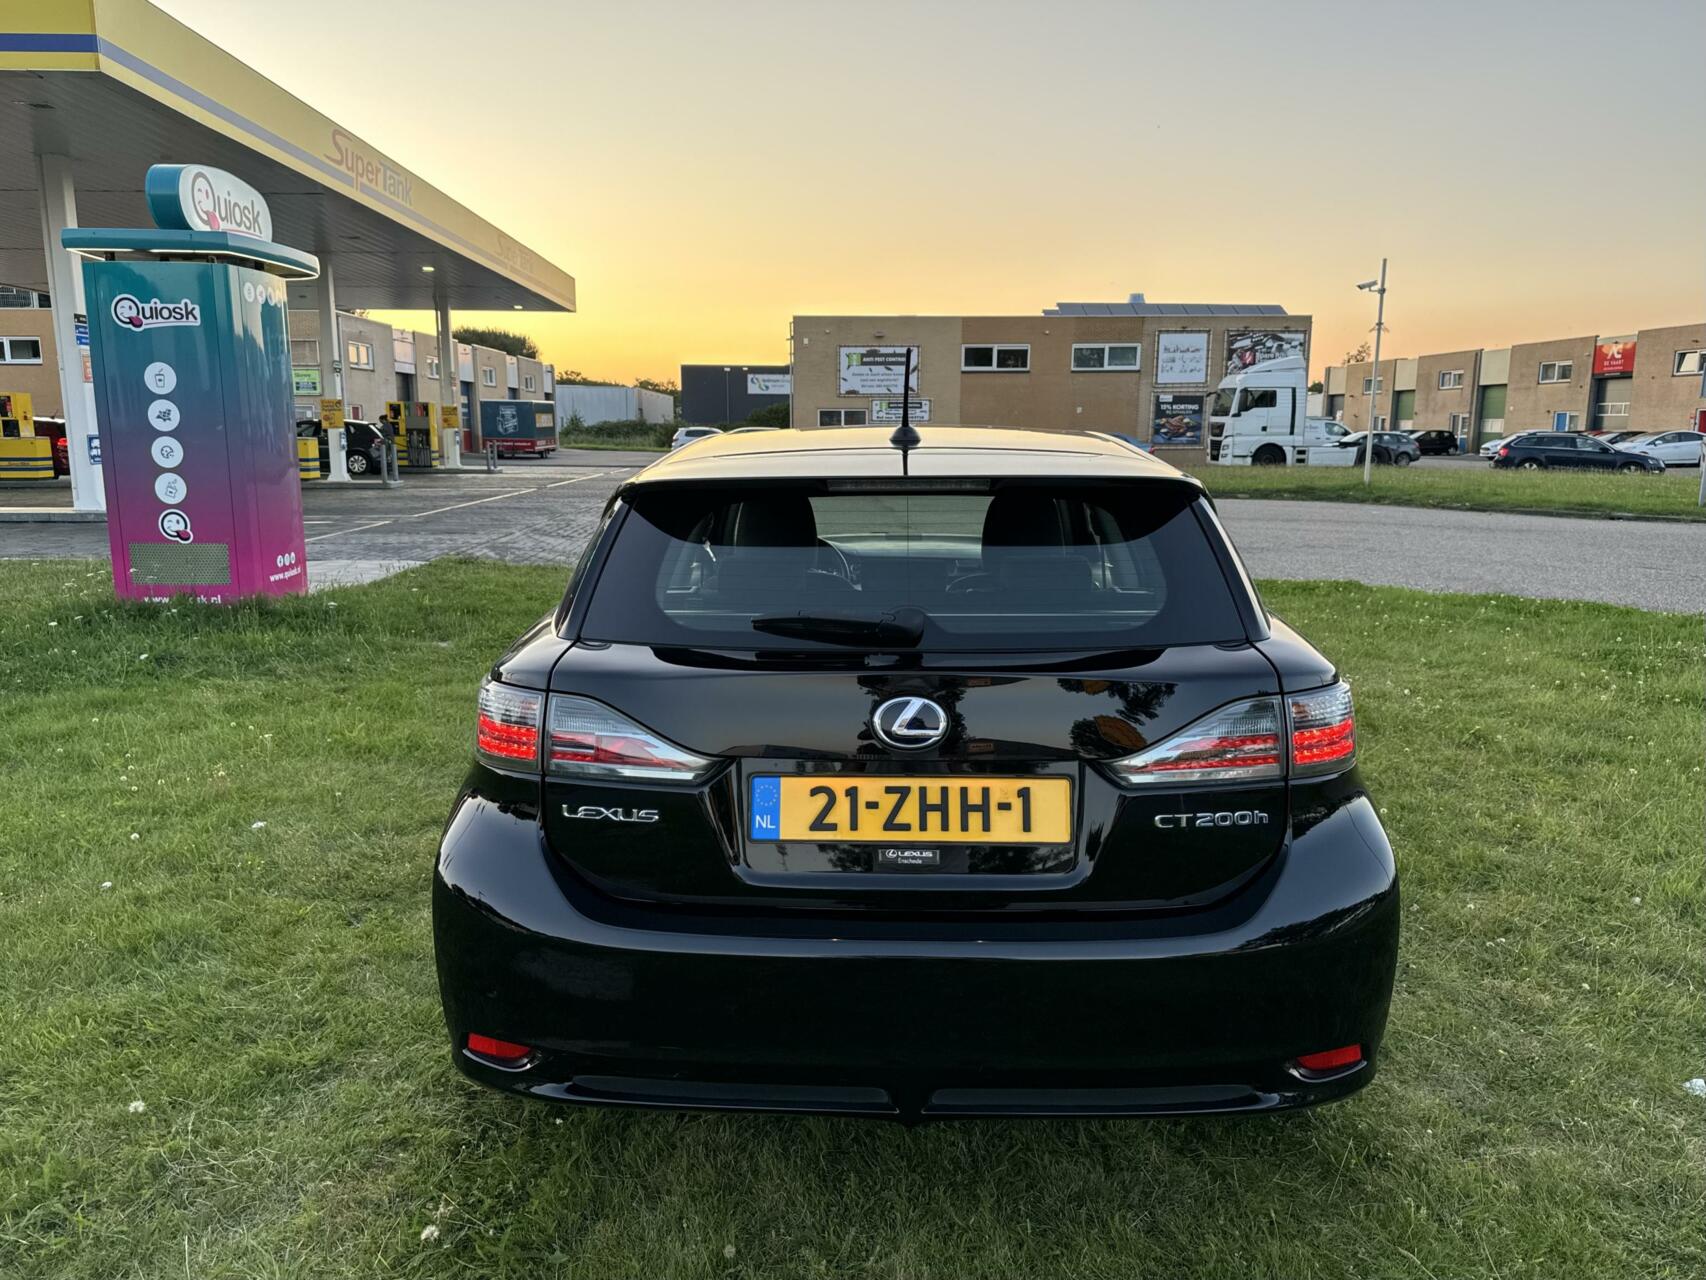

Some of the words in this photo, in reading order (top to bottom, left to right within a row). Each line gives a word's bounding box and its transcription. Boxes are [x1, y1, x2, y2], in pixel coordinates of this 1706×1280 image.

[191, 171, 263, 235] Quiosk
[113, 297, 199, 328] Quiosk
[561, 804, 660, 823] LEXUS
[754, 815, 776, 830] NL
[808, 785, 1032, 833] 21-ZHH-1
